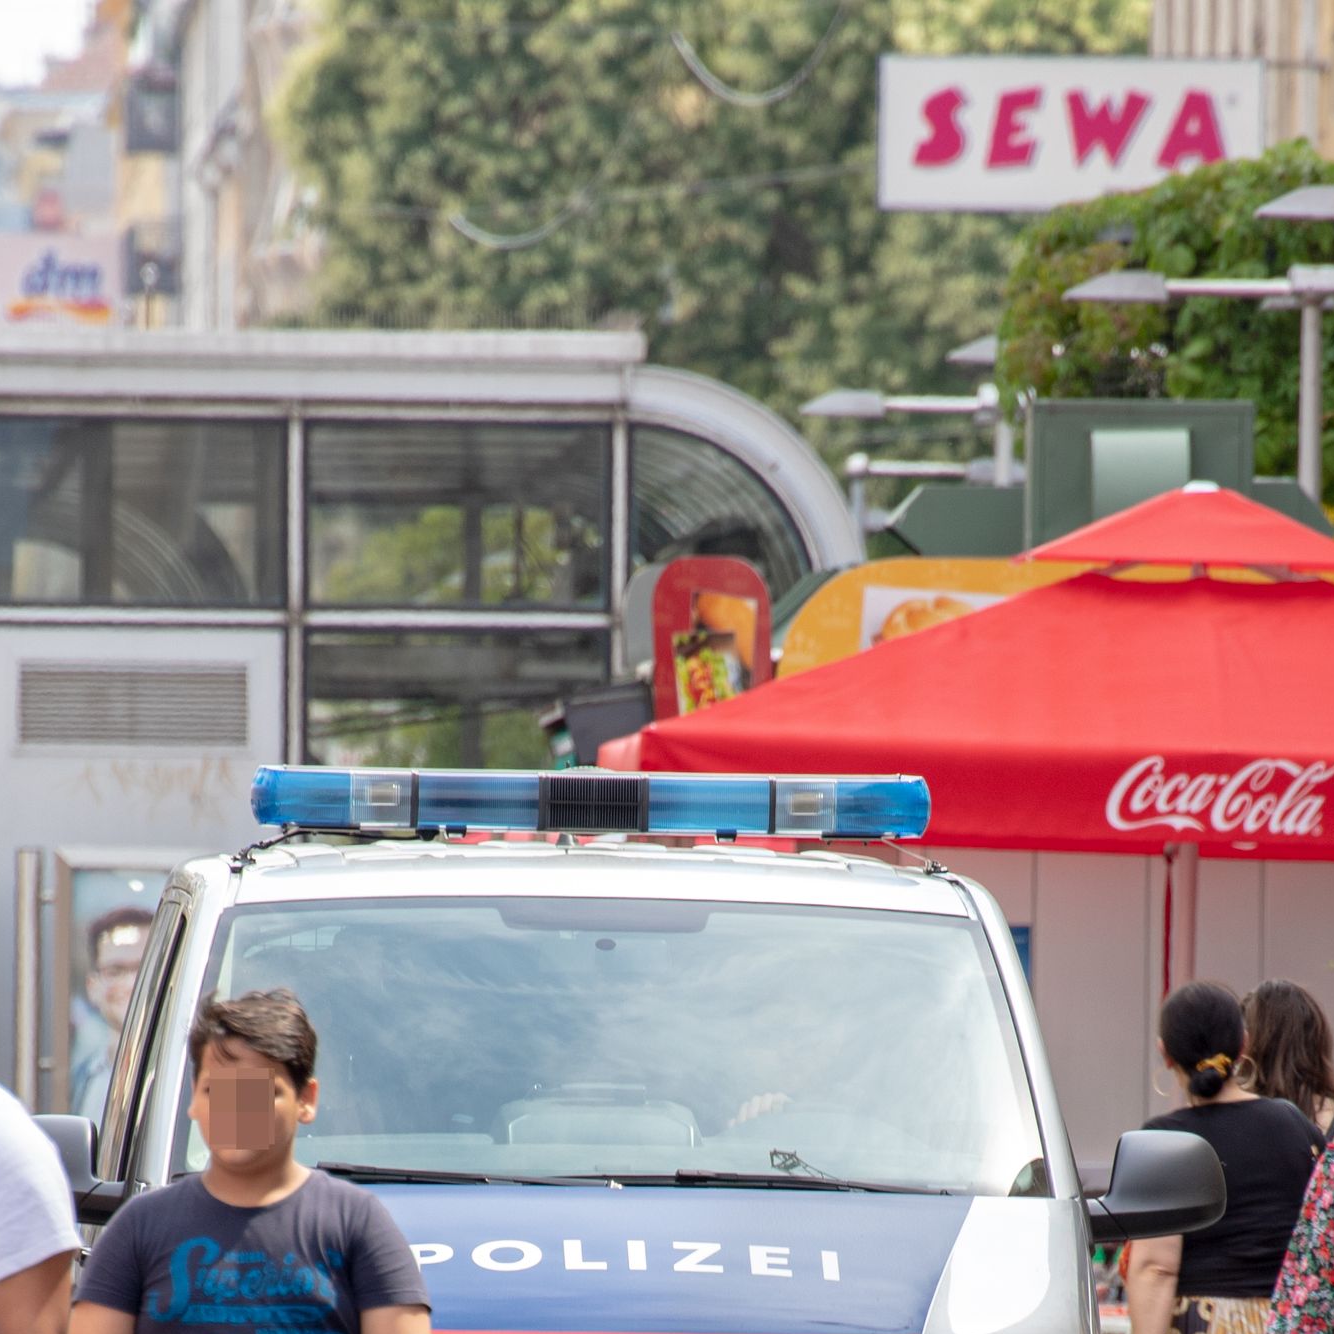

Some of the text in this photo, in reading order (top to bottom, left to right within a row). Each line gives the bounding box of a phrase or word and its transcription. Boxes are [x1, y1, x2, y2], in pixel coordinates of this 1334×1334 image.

[913, 86, 1227, 169] SEWA
[21, 249, 99, 297] dm
[409, 1239, 841, 1282] POLIZEI
